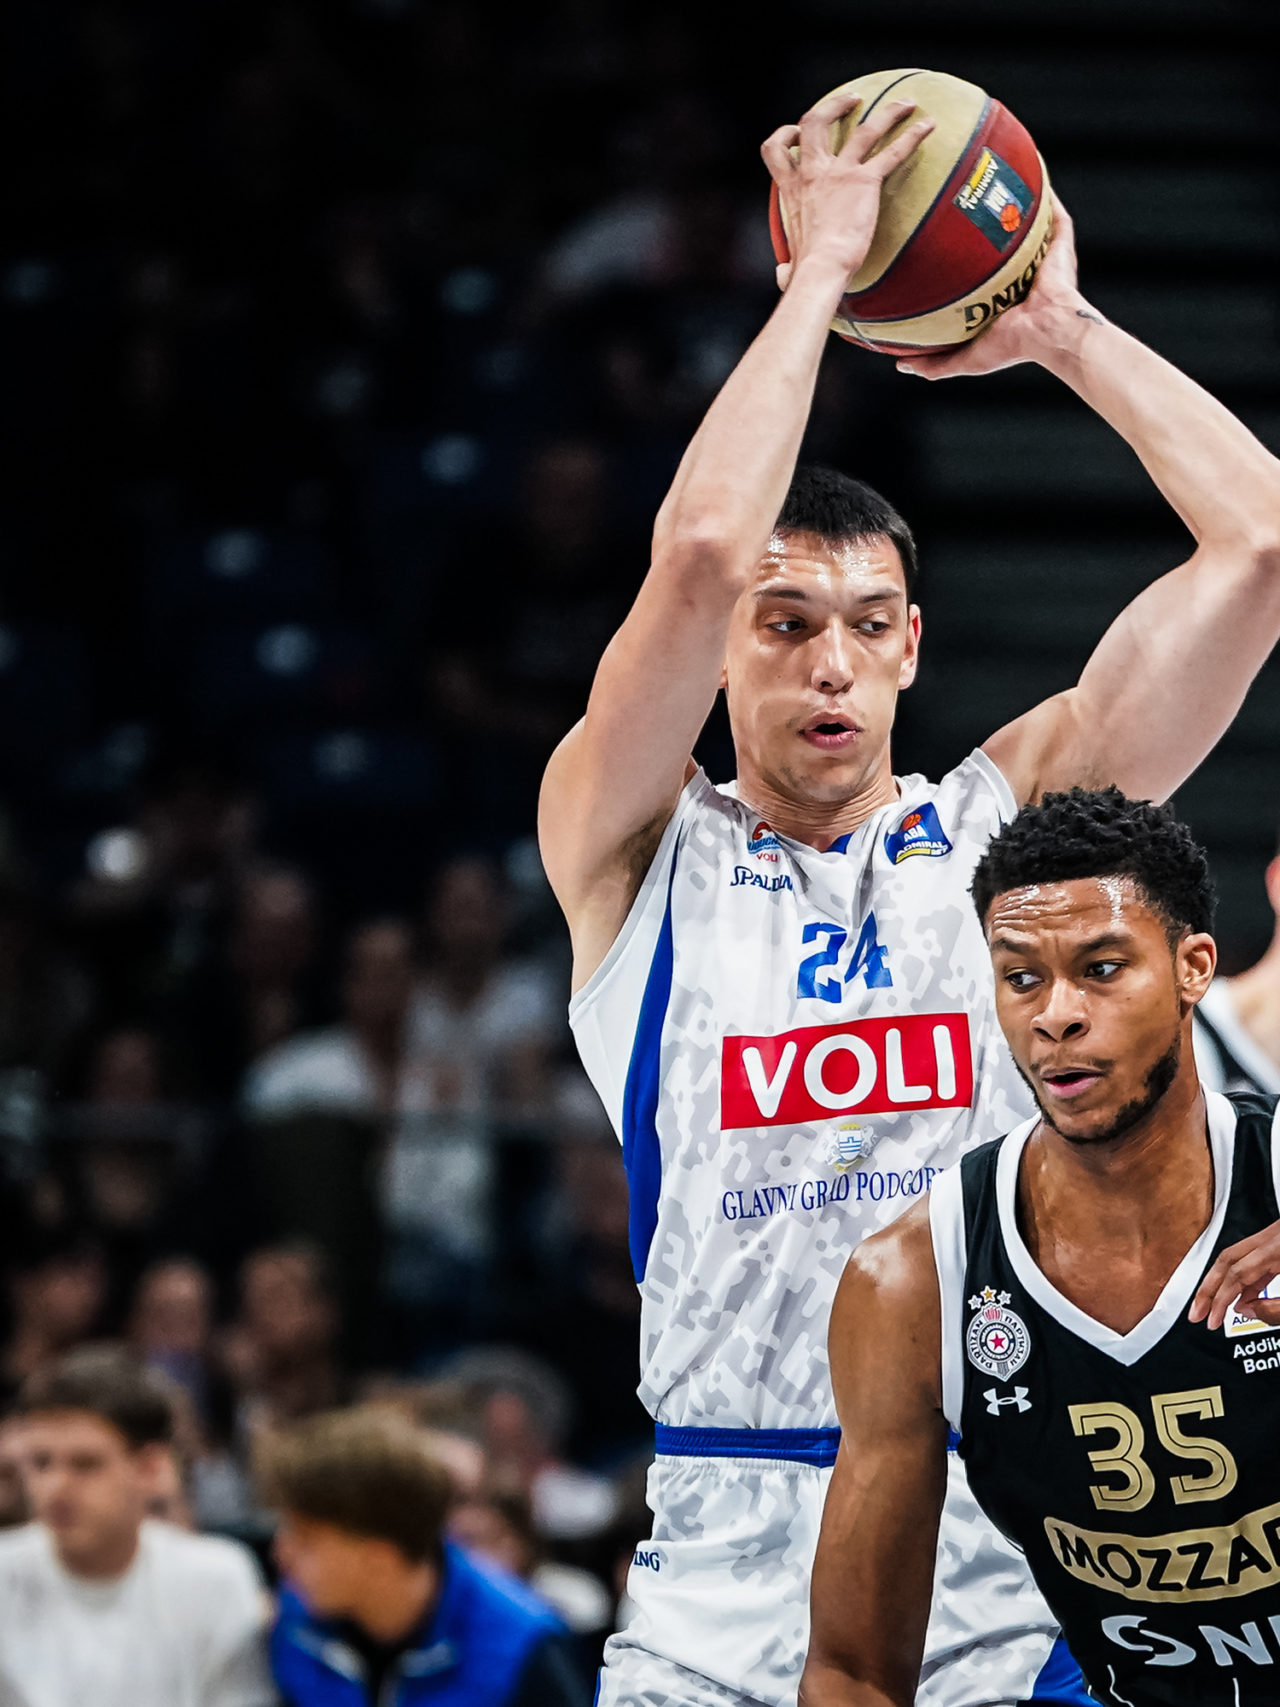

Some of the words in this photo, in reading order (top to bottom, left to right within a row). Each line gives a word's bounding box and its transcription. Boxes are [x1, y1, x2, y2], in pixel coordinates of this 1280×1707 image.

[903, 824, 928, 842] ABA
[797, 910, 893, 1003] 24
[742, 1024, 957, 1119] VOLI
[722, 1184, 798, 1221] GLAVNI
[856, 1167, 944, 1201] PODGOR
[970, 1320, 993, 1369] PARTIZAN
[1068, 1386, 1238, 1512] 35
